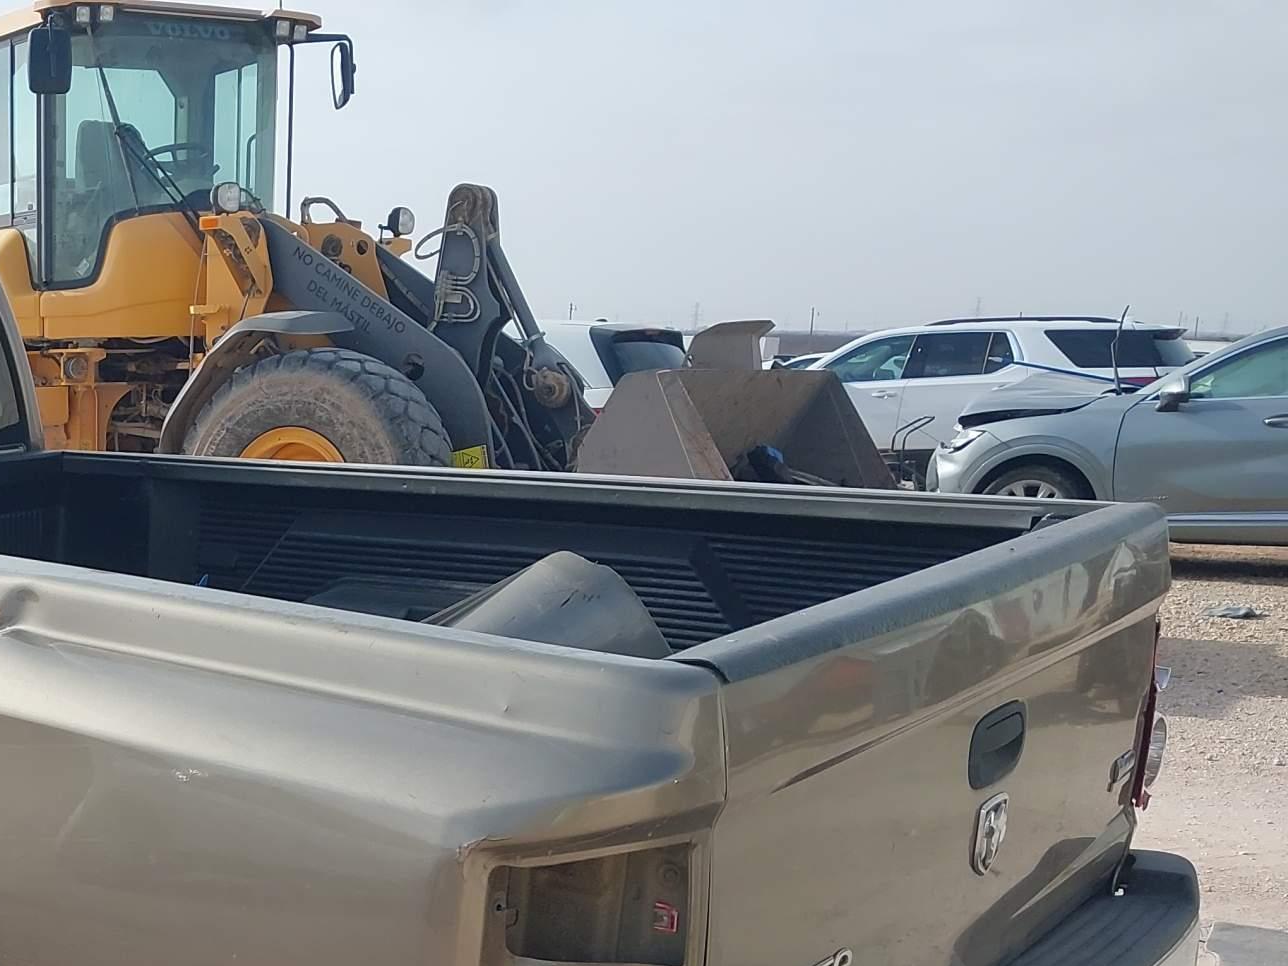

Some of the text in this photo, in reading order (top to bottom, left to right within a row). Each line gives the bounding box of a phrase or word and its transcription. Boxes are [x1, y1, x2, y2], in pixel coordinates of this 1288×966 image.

[145, 21, 230, 39] VOLVO
[293, 247, 406, 334] NO CAMINE DEBAJO
[306, 280, 329, 302] DEL
